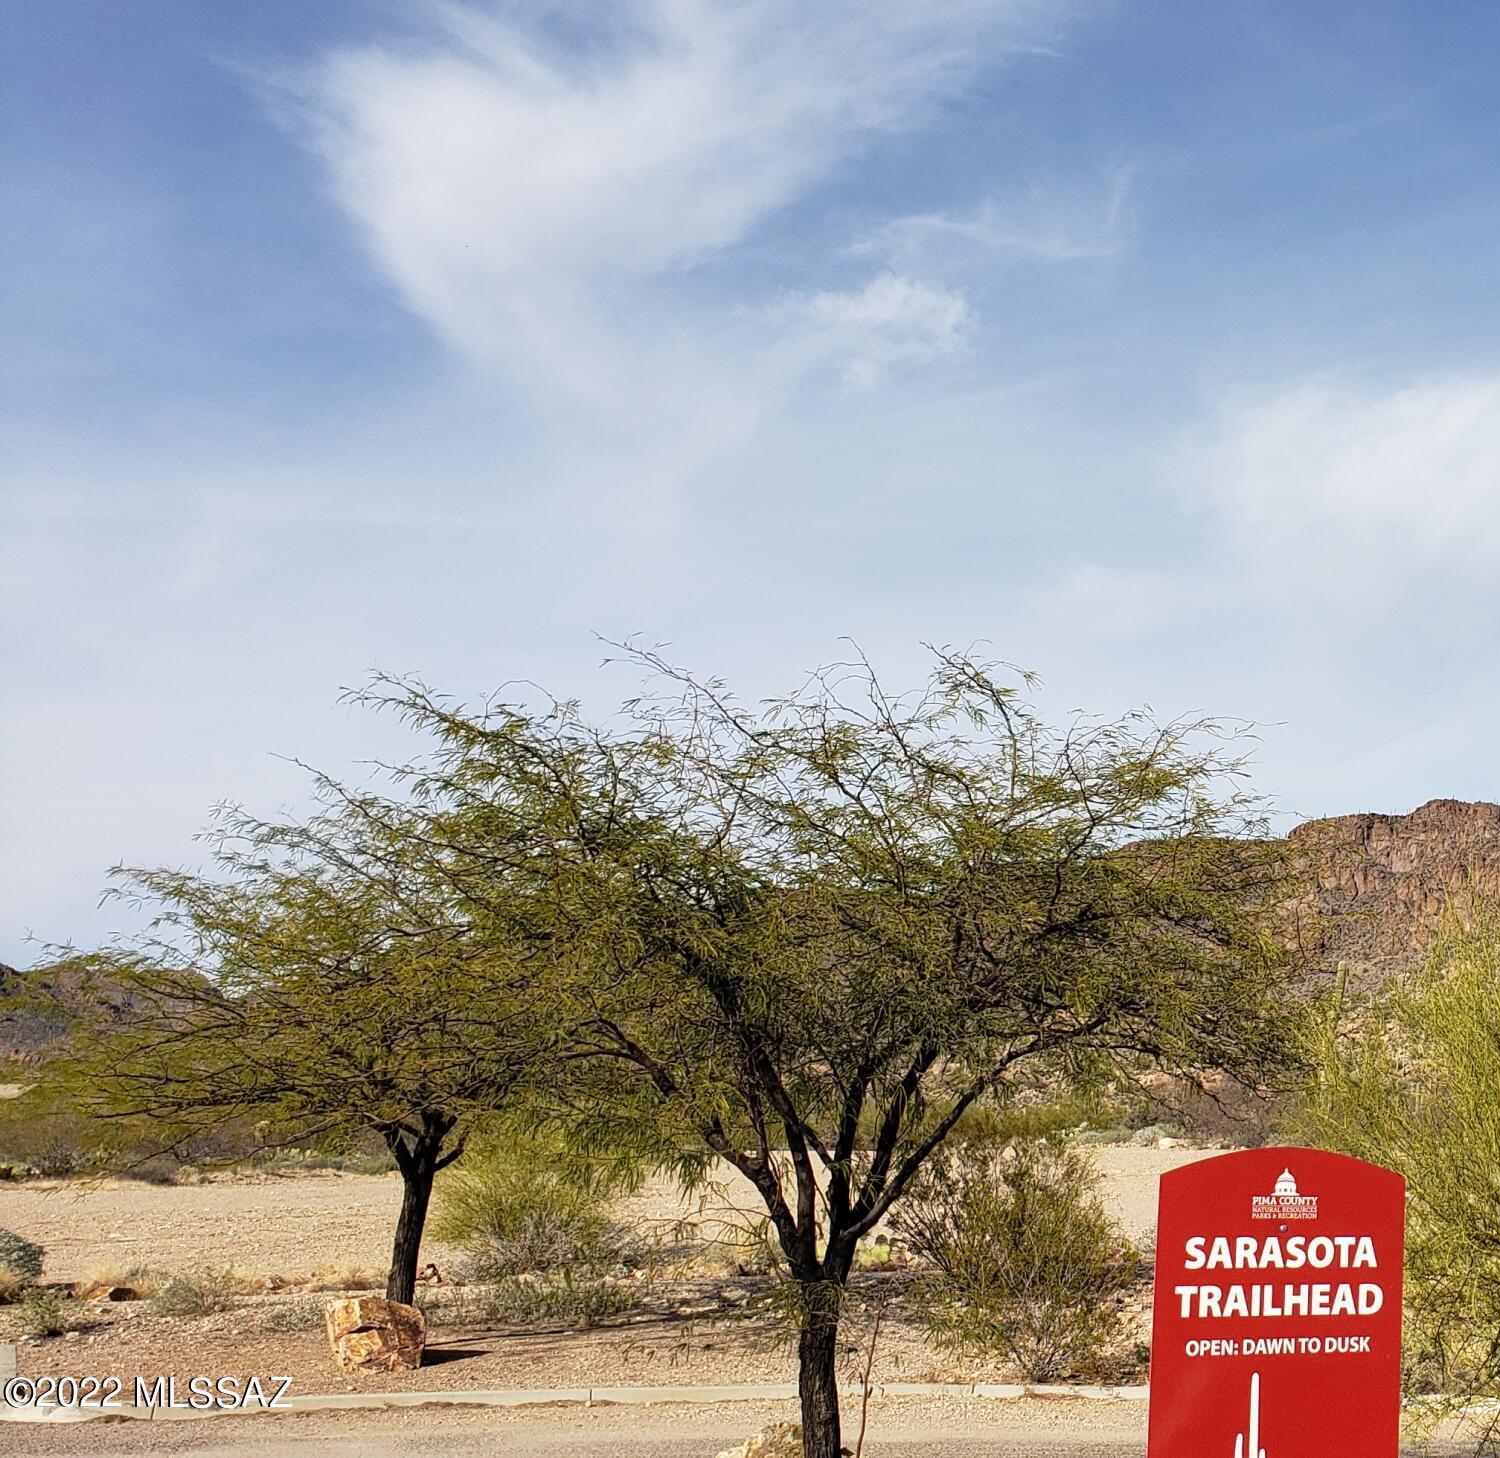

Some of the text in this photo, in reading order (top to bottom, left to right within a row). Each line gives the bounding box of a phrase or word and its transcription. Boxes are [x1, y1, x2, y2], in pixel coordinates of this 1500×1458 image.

[1252, 1196, 1318, 1205] PIMA COUNTY
[1184, 1236, 1378, 1269] SARASOTA
[1174, 1283, 1384, 1318] TRAILHEAD
[1185, 1336, 1371, 1357] OPEN: DAWN TO DUSK
